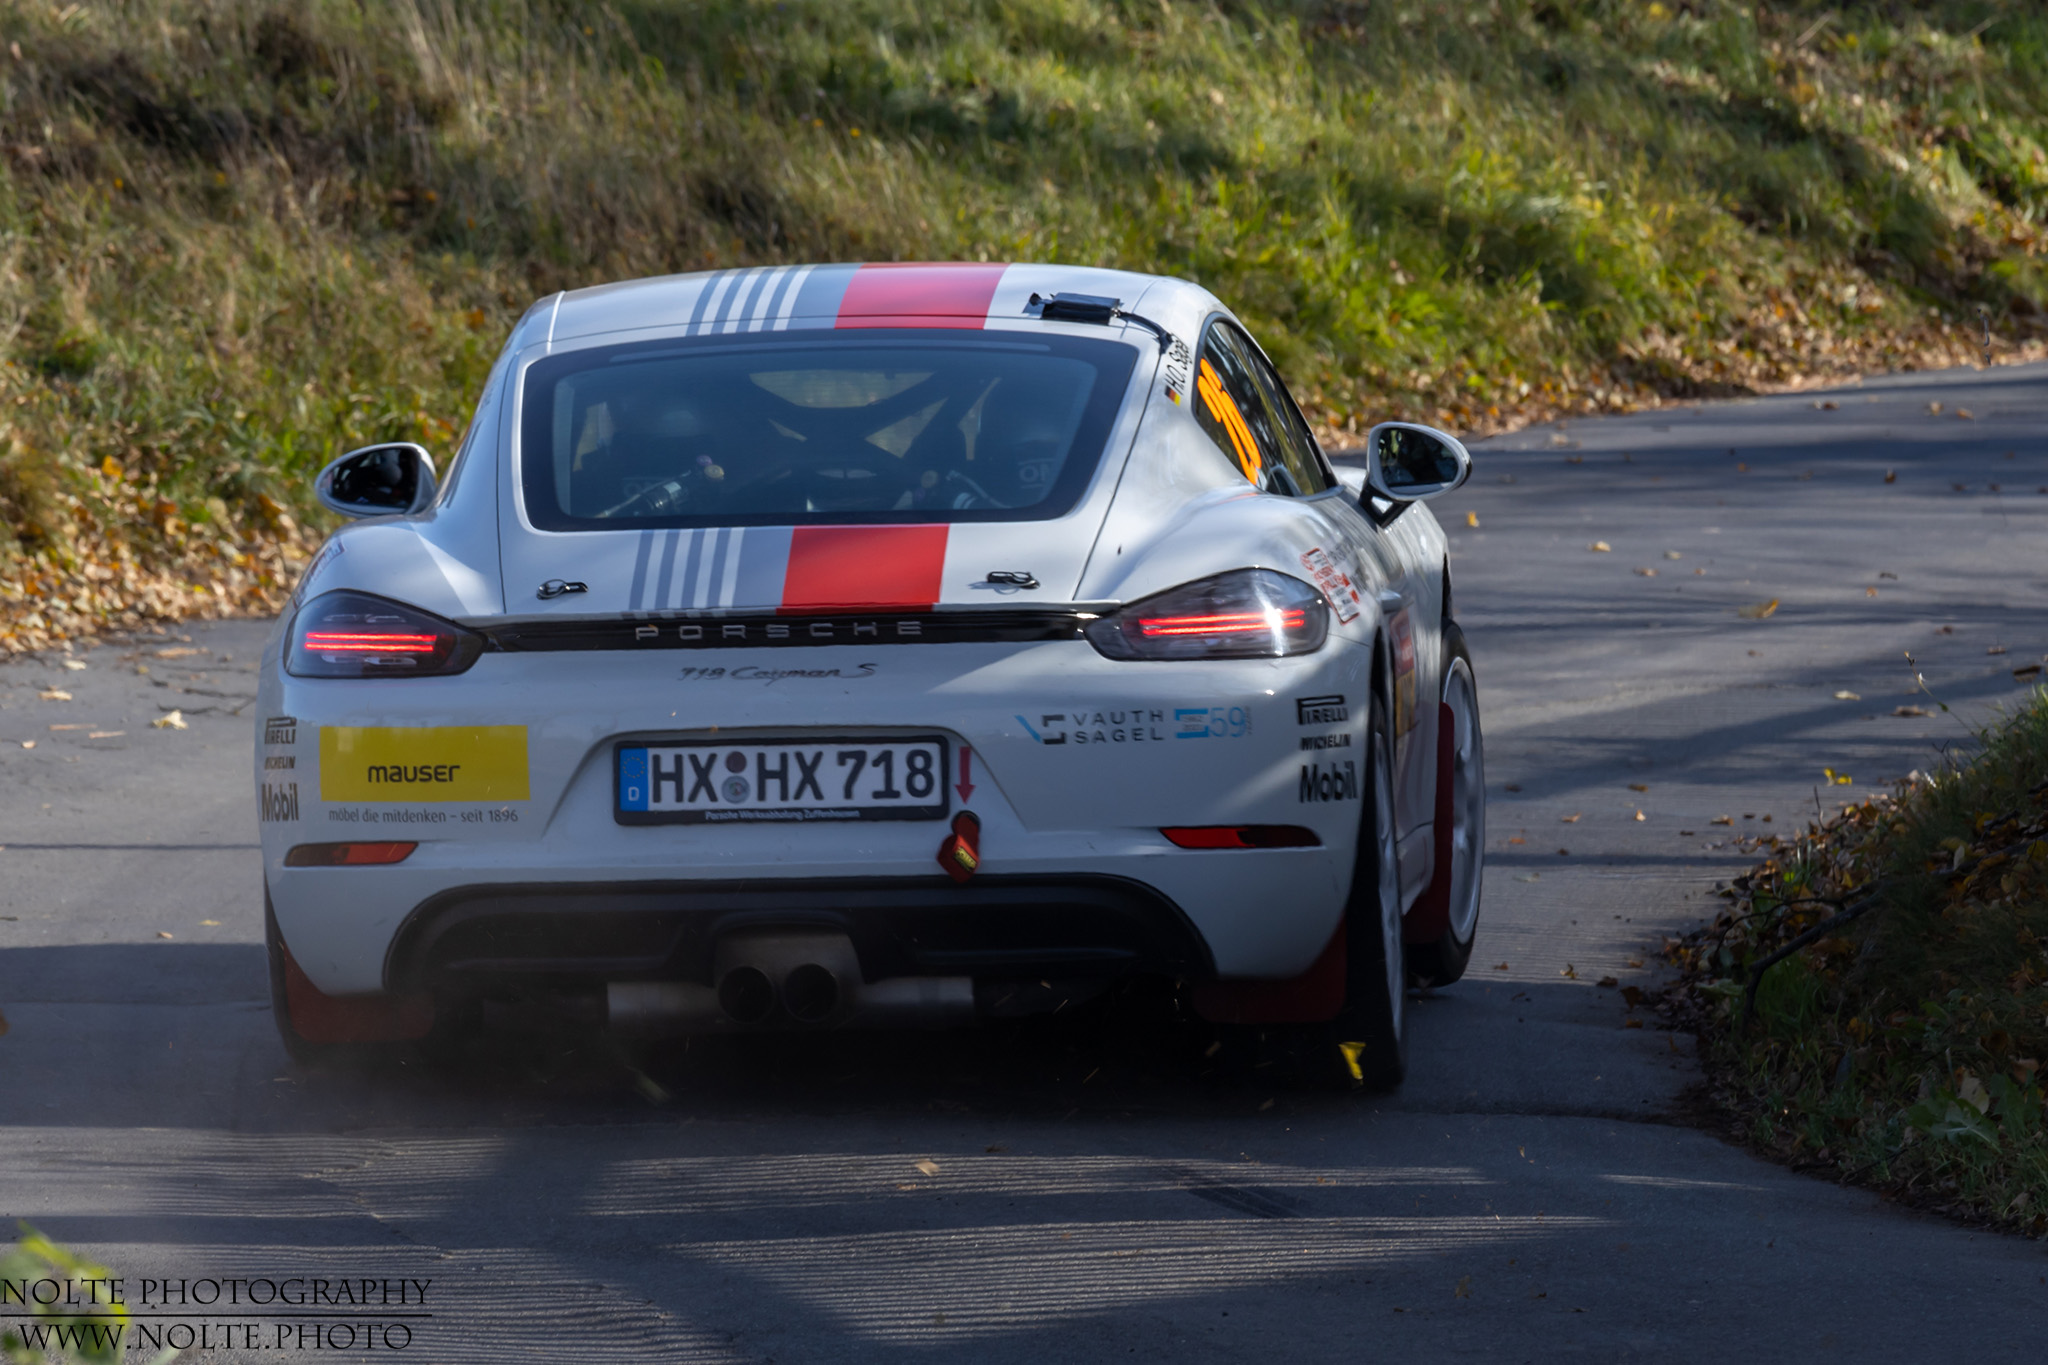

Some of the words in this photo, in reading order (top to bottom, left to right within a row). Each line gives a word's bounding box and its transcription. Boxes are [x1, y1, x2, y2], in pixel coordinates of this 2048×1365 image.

[635, 621, 922, 640] PORSCHE
[677, 666, 726, 681] 718
[731, 666, 840, 687] Cayman
[838, 663, 878, 679] S
[1072, 709, 1164, 727] VAUTH
[1296, 694, 1349, 726] PIRELLI
[264, 716, 297, 745] PIRELLI
[1210, 706, 1247, 738] 59
[1075, 727, 1165, 745] SAGEL
[1299, 733, 1352, 751] MICHELIN
[367, 765, 461, 783] mauser
[652, 752, 718, 803] HX
[756, 751, 824, 801] HX
[836, 749, 935, 800] 718
[1299, 760, 1358, 804] Mobil
[261, 782, 299, 822] Mobil
[627, 785, 640, 801] D
[362, 808, 379, 822] die
[382, 807, 446, 823] mitdenken
[460, 808, 483, 822] seit
[489, 808, 519, 823] 1896
